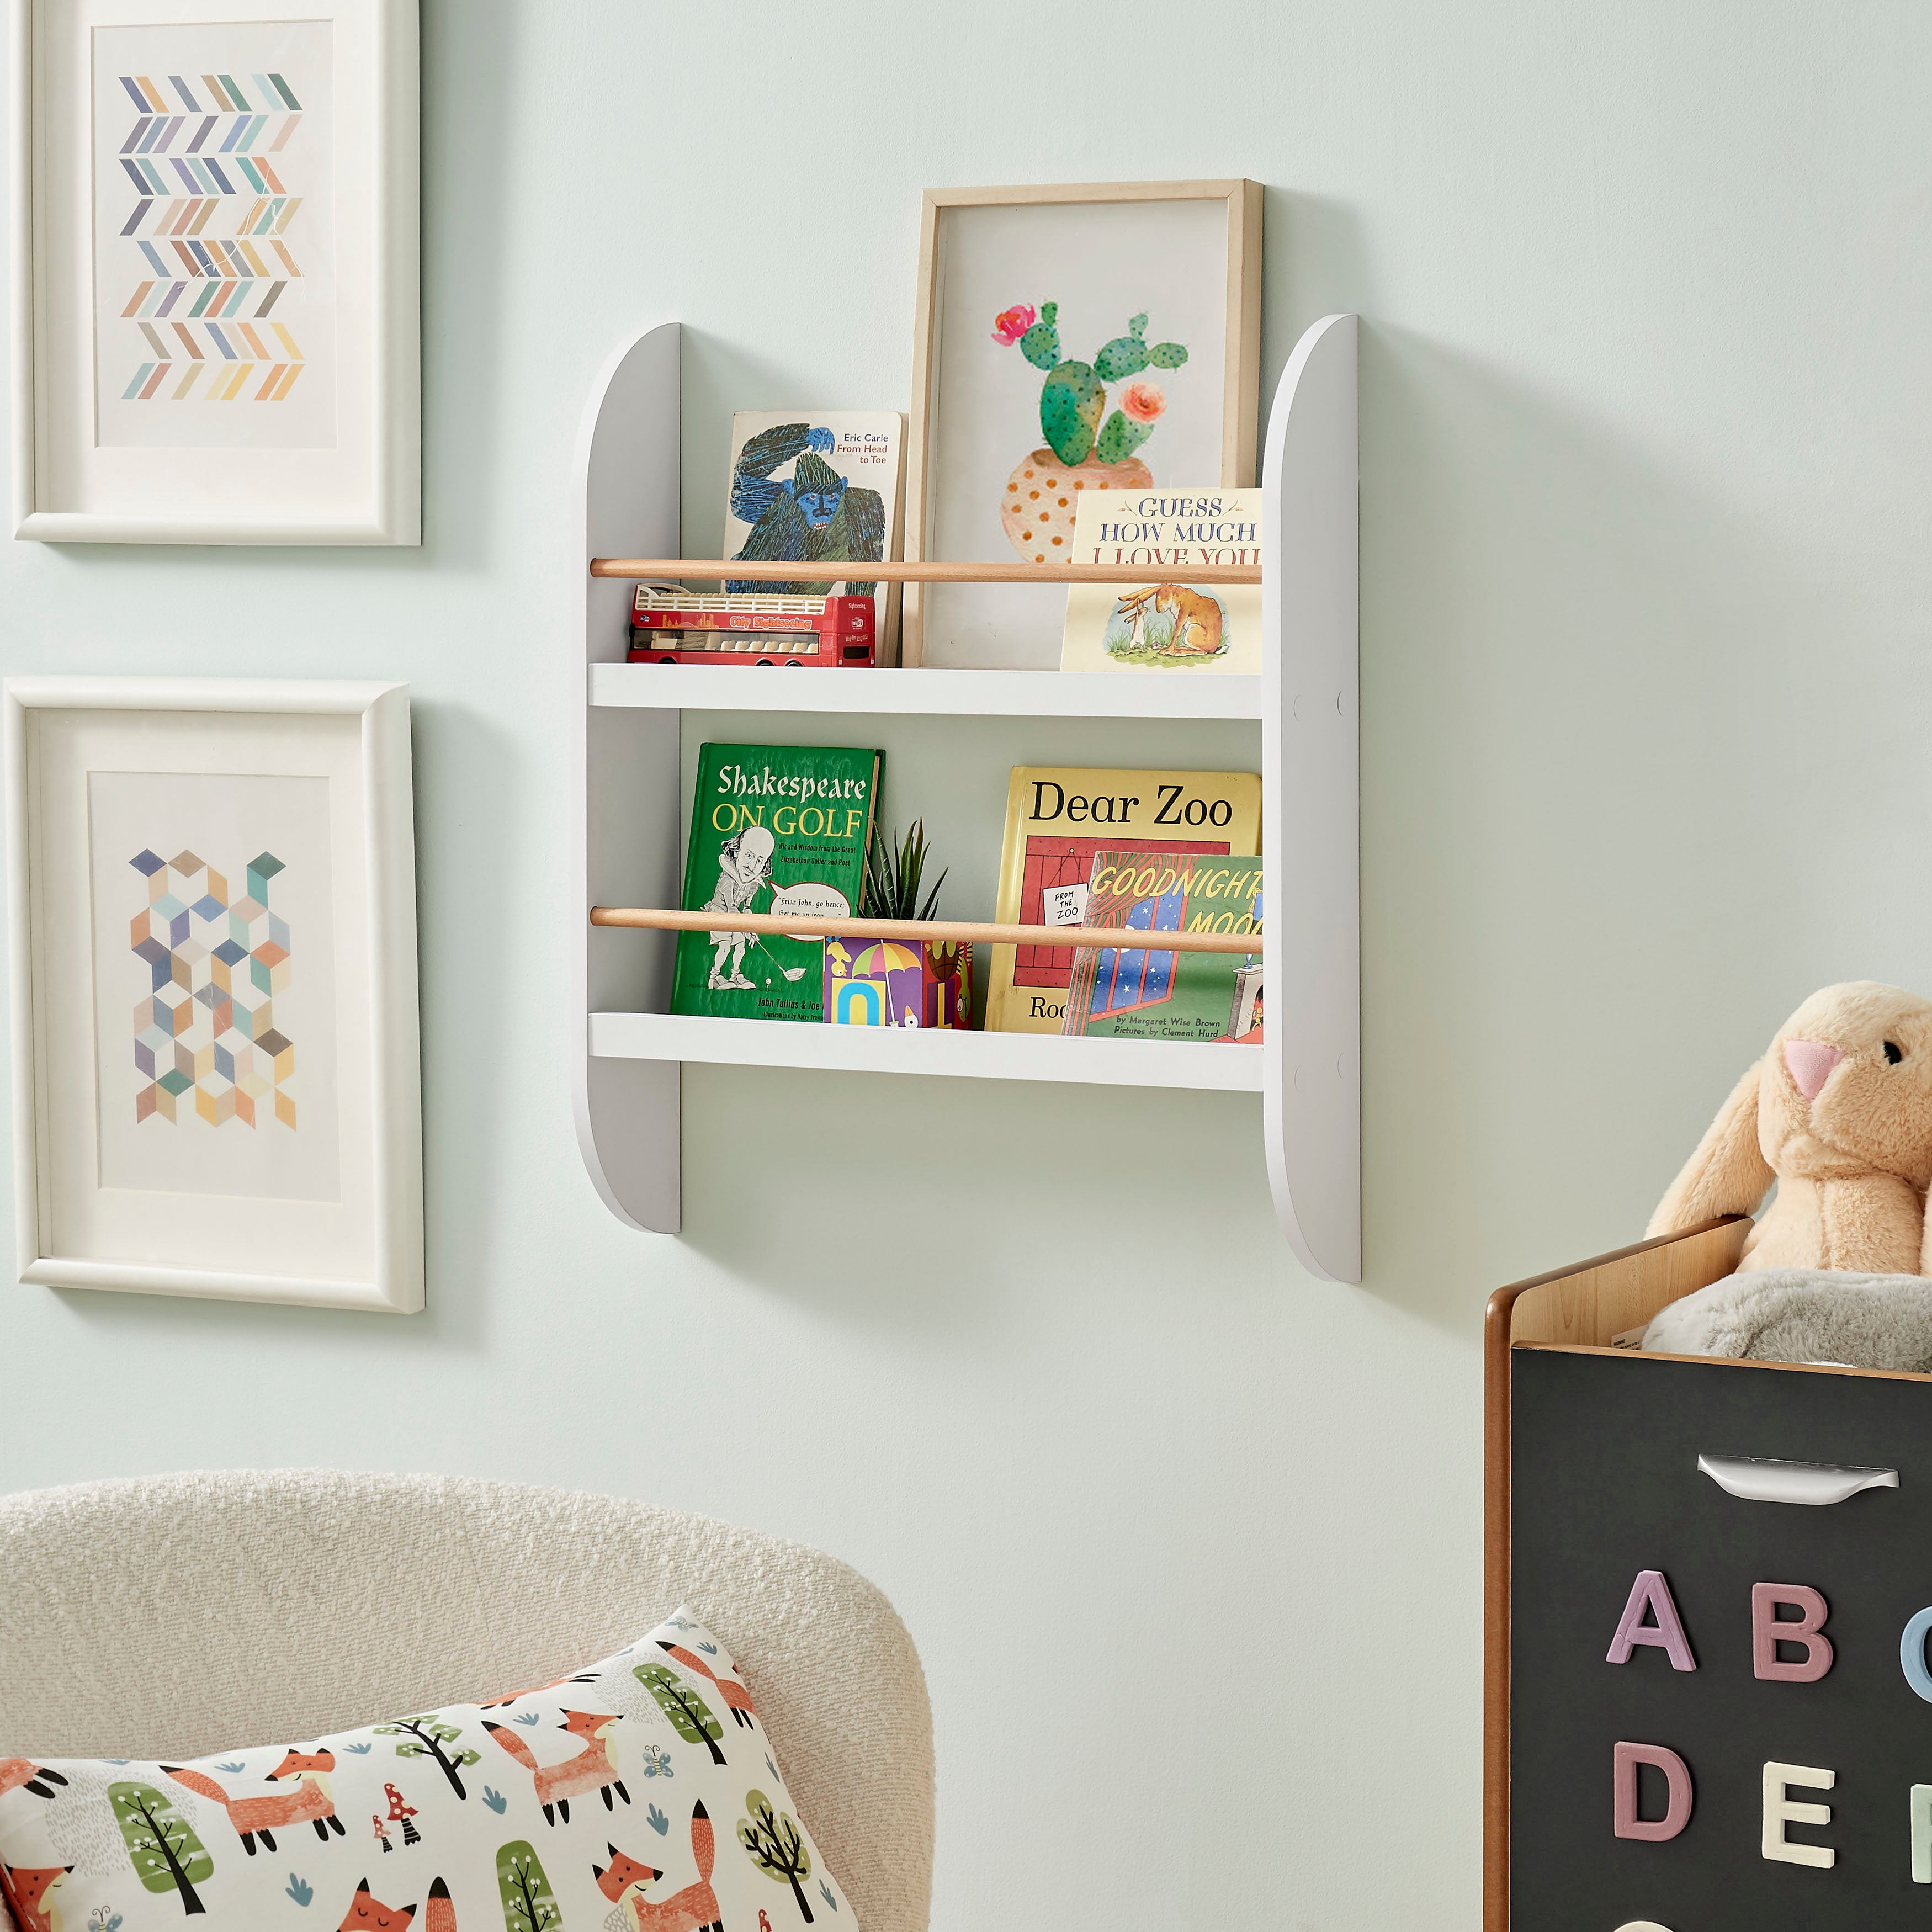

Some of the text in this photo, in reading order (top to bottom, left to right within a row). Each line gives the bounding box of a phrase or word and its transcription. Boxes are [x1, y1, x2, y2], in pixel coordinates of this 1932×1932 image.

[844, 433, 888, 442] Eric Carle
[837, 444, 887, 453] From Head
[871, 455, 887, 464] Toe
[1138, 497, 1223, 518] GUESS
[1098, 522, 1258, 543] HOW MUCH
[1093, 548, 1262, 565] I LOVE YOU
[729, 615, 813, 631] City Sightseeing
[717, 765, 867, 803] Shakespeare
[1028, 781, 1233, 827] Dear Zoo
[712, 803, 863, 837] ON GOLF
[798, 843, 818, 852] Wisdom
[781, 856, 810, 864] Elizabethan
[811, 857, 826, 866] Golfer
[1091, 866, 1263, 900] GOODNIGHT
[1055, 890, 1074, 901] FROM
[798, 898, 814, 907] John,
[1059, 899, 1073, 909] THE
[1057, 906, 1079, 920] ZOO
[758, 997, 820, 1010] John Tullius & Joe
[1116, 1015, 1220, 1027] by Margaret Wise Brown
[1114, 1026, 1219, 1038] Pictures by Clement Hurd
[1605, 1569, 1698, 1673] A
[1751, 1582, 1834, 1683] B
[1613, 1740, 1693, 1843] D
[1761, 1760, 1836, 1870] E
